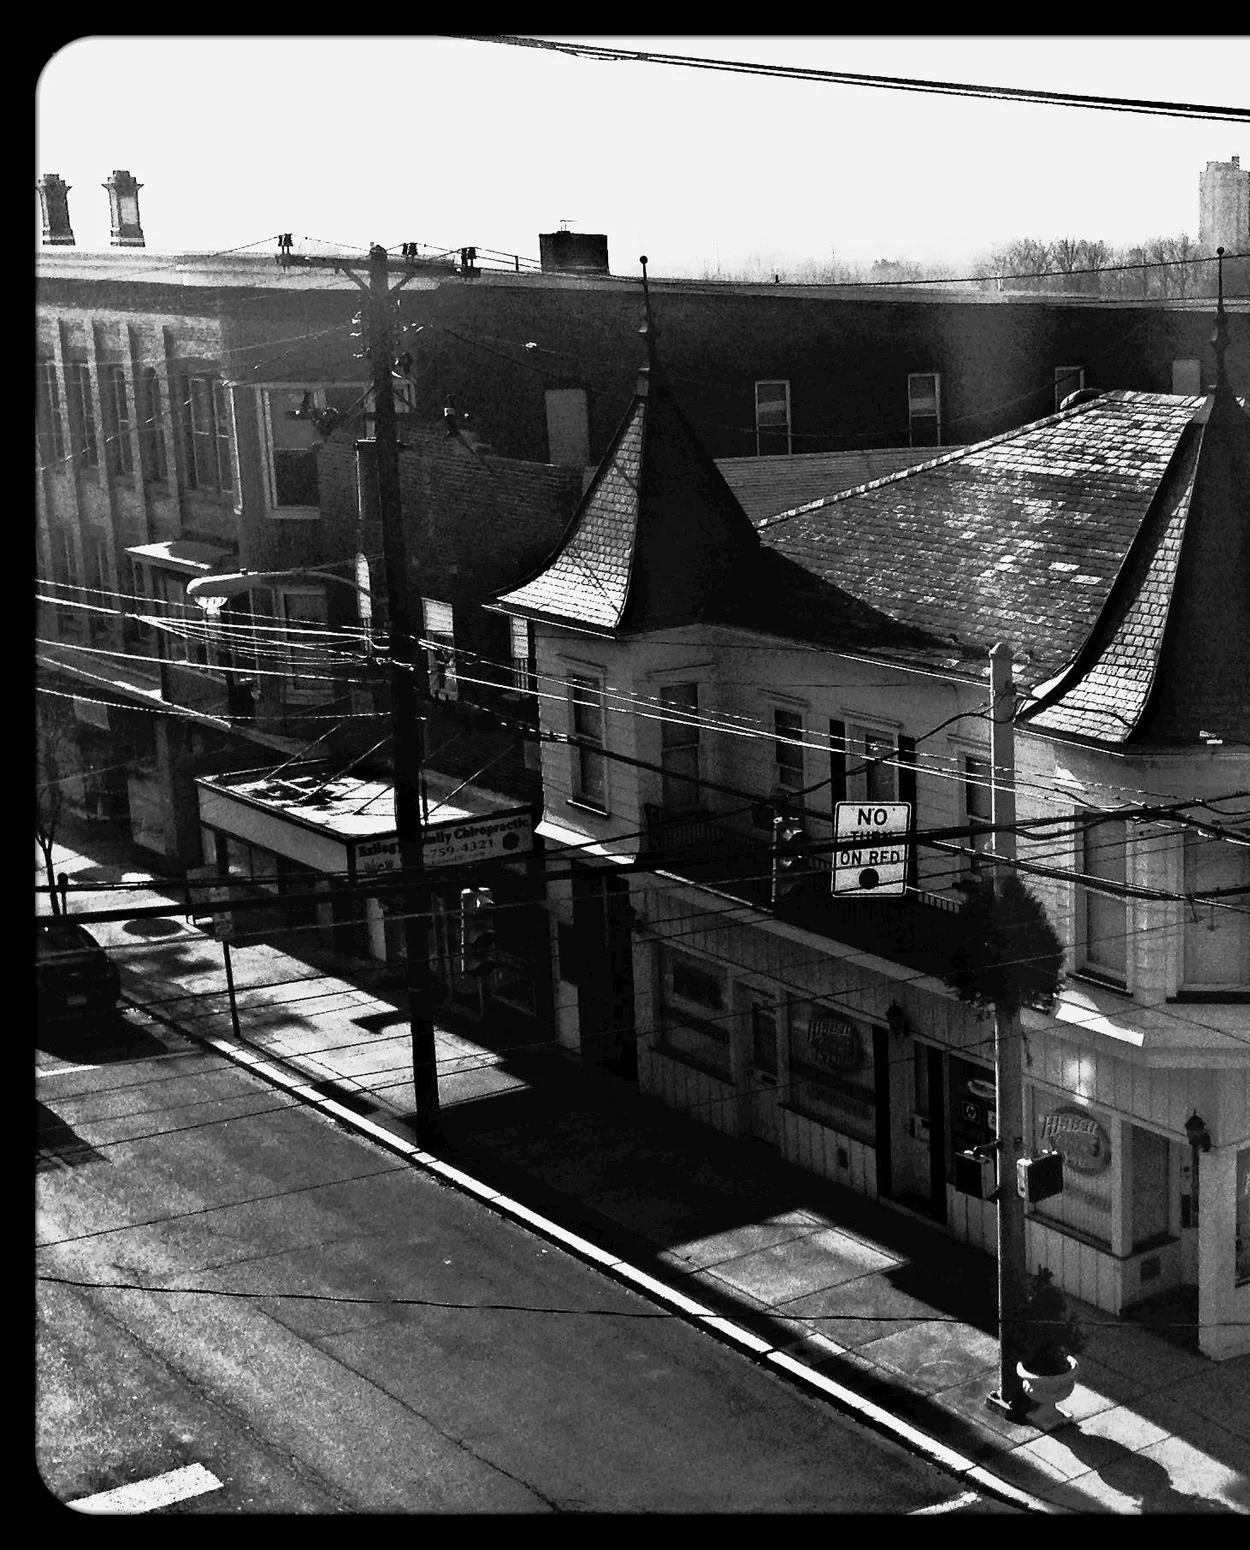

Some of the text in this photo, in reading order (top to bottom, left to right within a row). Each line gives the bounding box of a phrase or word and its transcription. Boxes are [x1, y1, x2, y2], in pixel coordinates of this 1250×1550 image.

[857, 808, 888, 825] NO
[454, 817, 529, 839] Chiropractic
[840, 850, 899, 865] ON RED
